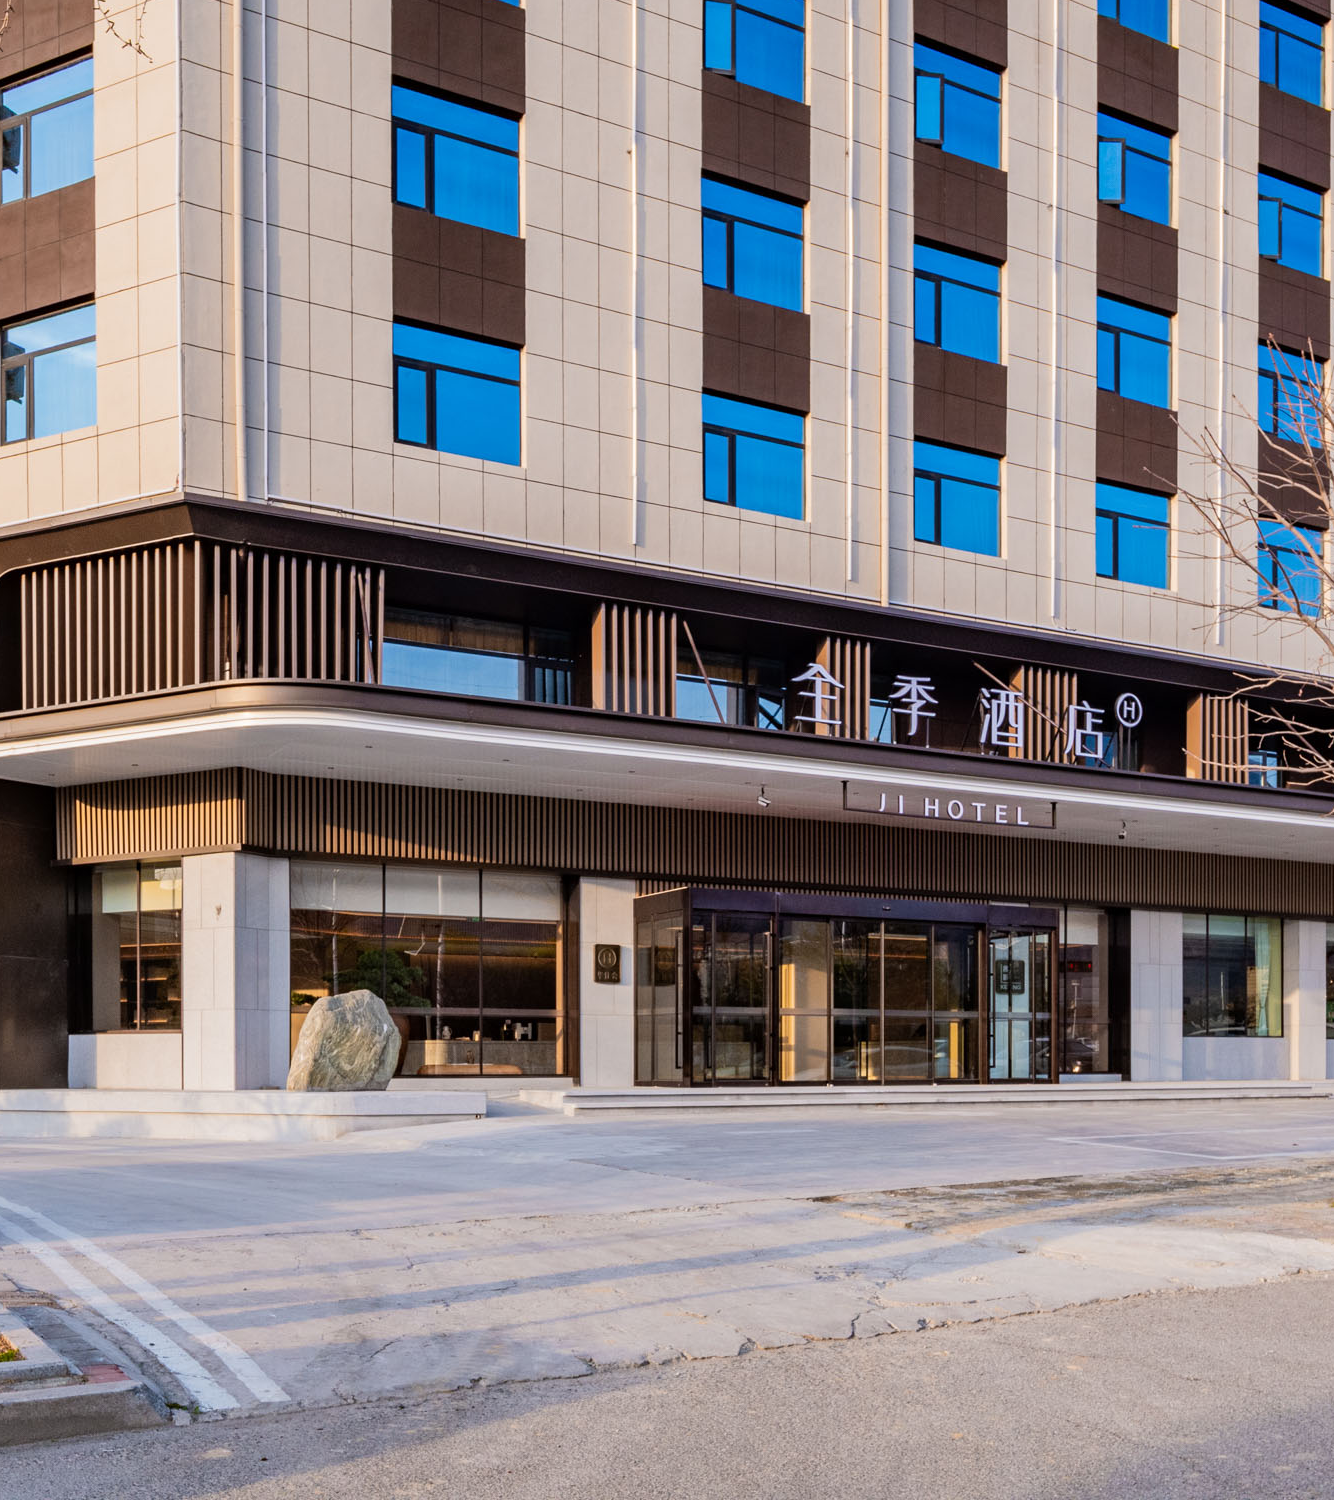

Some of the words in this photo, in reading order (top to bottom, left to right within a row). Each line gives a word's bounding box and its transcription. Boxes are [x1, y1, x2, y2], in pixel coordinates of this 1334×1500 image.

[791, 662, 1105, 759] 全季酒店
[879, 792, 904, 814] JI
[924, 797, 1029, 826] HOTEL
